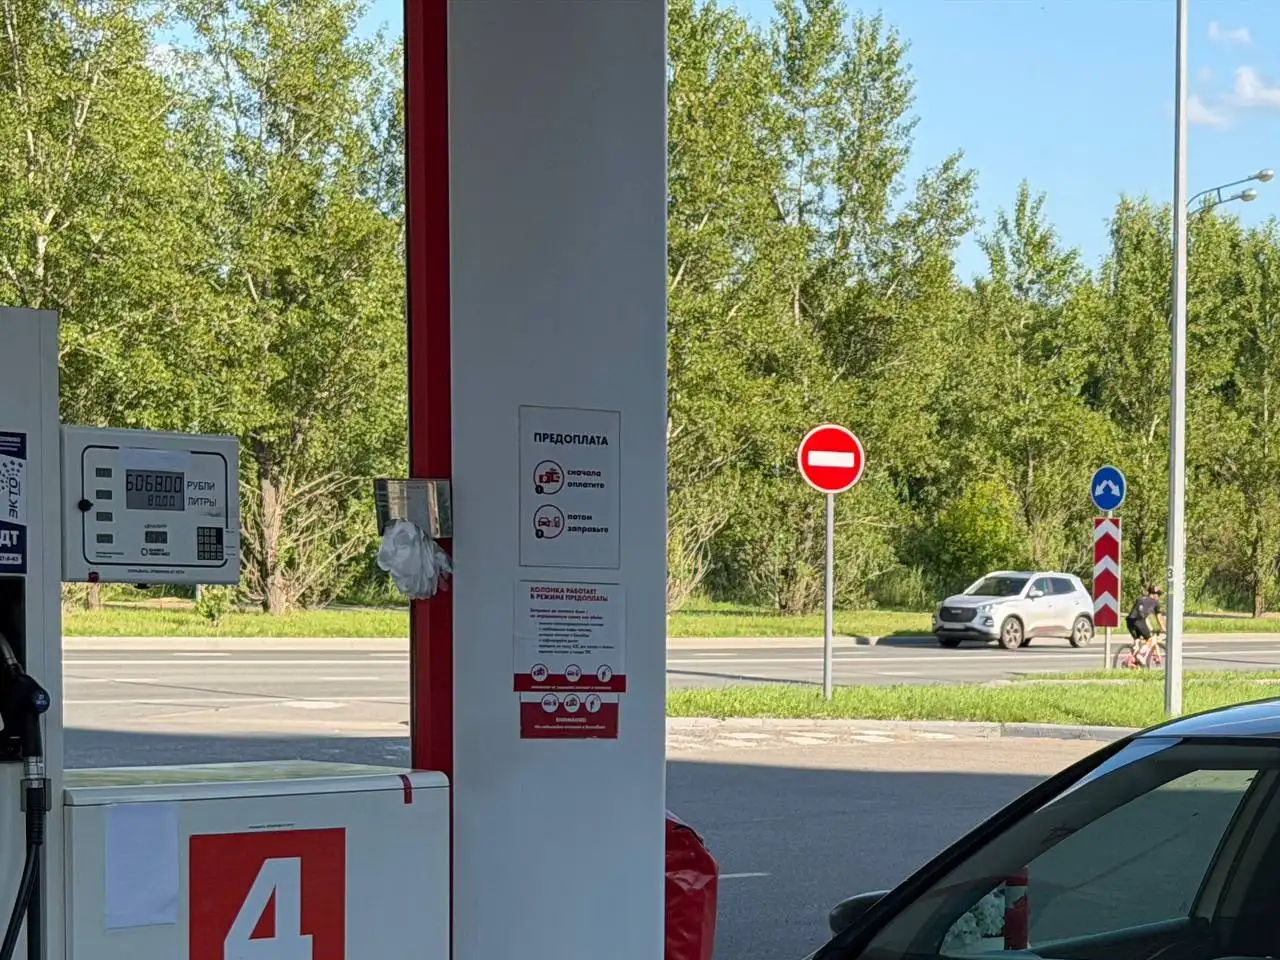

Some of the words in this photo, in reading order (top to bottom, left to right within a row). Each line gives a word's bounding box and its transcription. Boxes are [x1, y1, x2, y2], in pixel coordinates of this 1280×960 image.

[533, 432, 609, 446] ПРЕДОПЛАТА
[187, 480, 215, 490] РУБЛИ
[567, 481, 605, 489] оплатите
[9, 477, 18, 519] ЭКТО
[187, 497, 217, 507] ЛИТРЫ
[0, 530, 19, 547] ДТ
